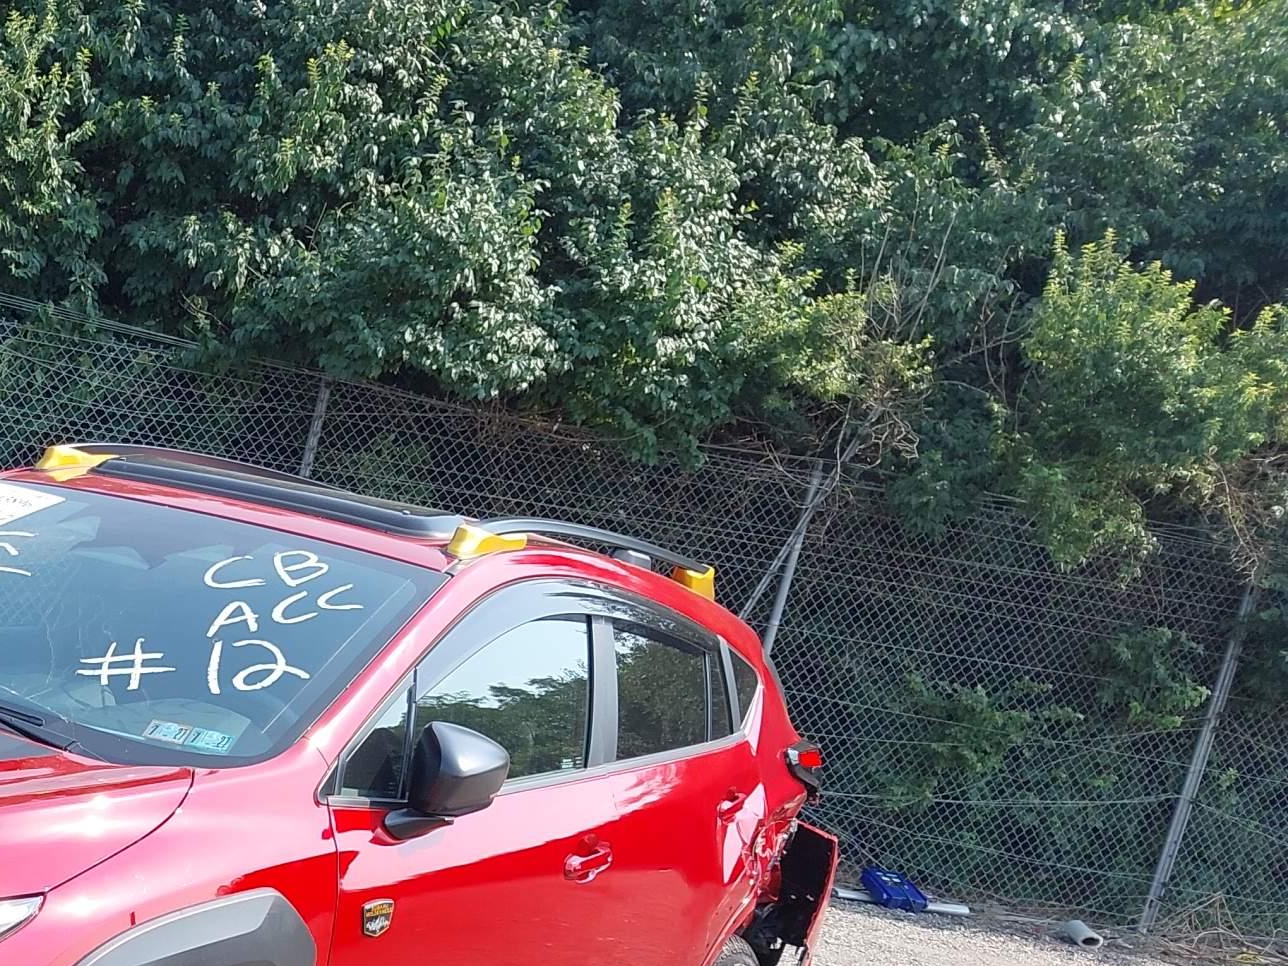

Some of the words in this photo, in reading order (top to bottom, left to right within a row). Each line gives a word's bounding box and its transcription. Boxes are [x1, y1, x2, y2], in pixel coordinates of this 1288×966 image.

[204, 550, 329, 588] CB
[206, 583, 364, 637] ACC
[75, 637, 177, 690] #
[207, 639, 311, 695] 12
